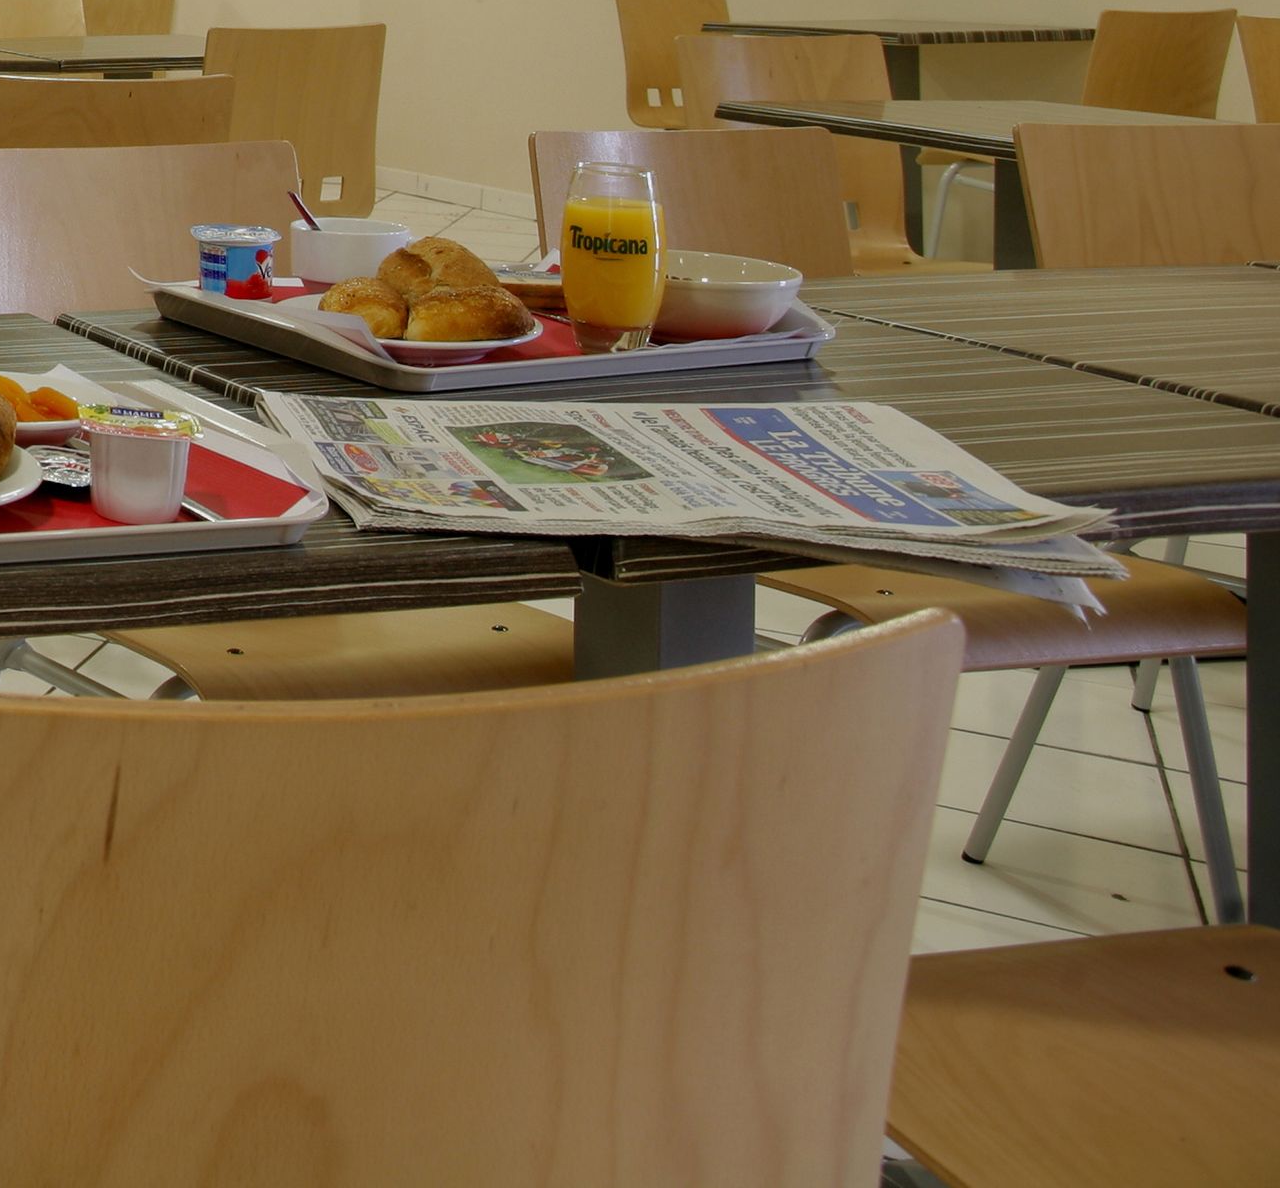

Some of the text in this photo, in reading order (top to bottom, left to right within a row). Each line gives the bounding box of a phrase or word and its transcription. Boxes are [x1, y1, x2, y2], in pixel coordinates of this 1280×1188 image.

[570, 225, 648, 255] Tropicana
[123, 410, 161, 419] MAMET
[399, 415, 441, 442] ESPACE
[745, 440, 791, 451] LE
[765, 430, 908, 507] La Tribune
